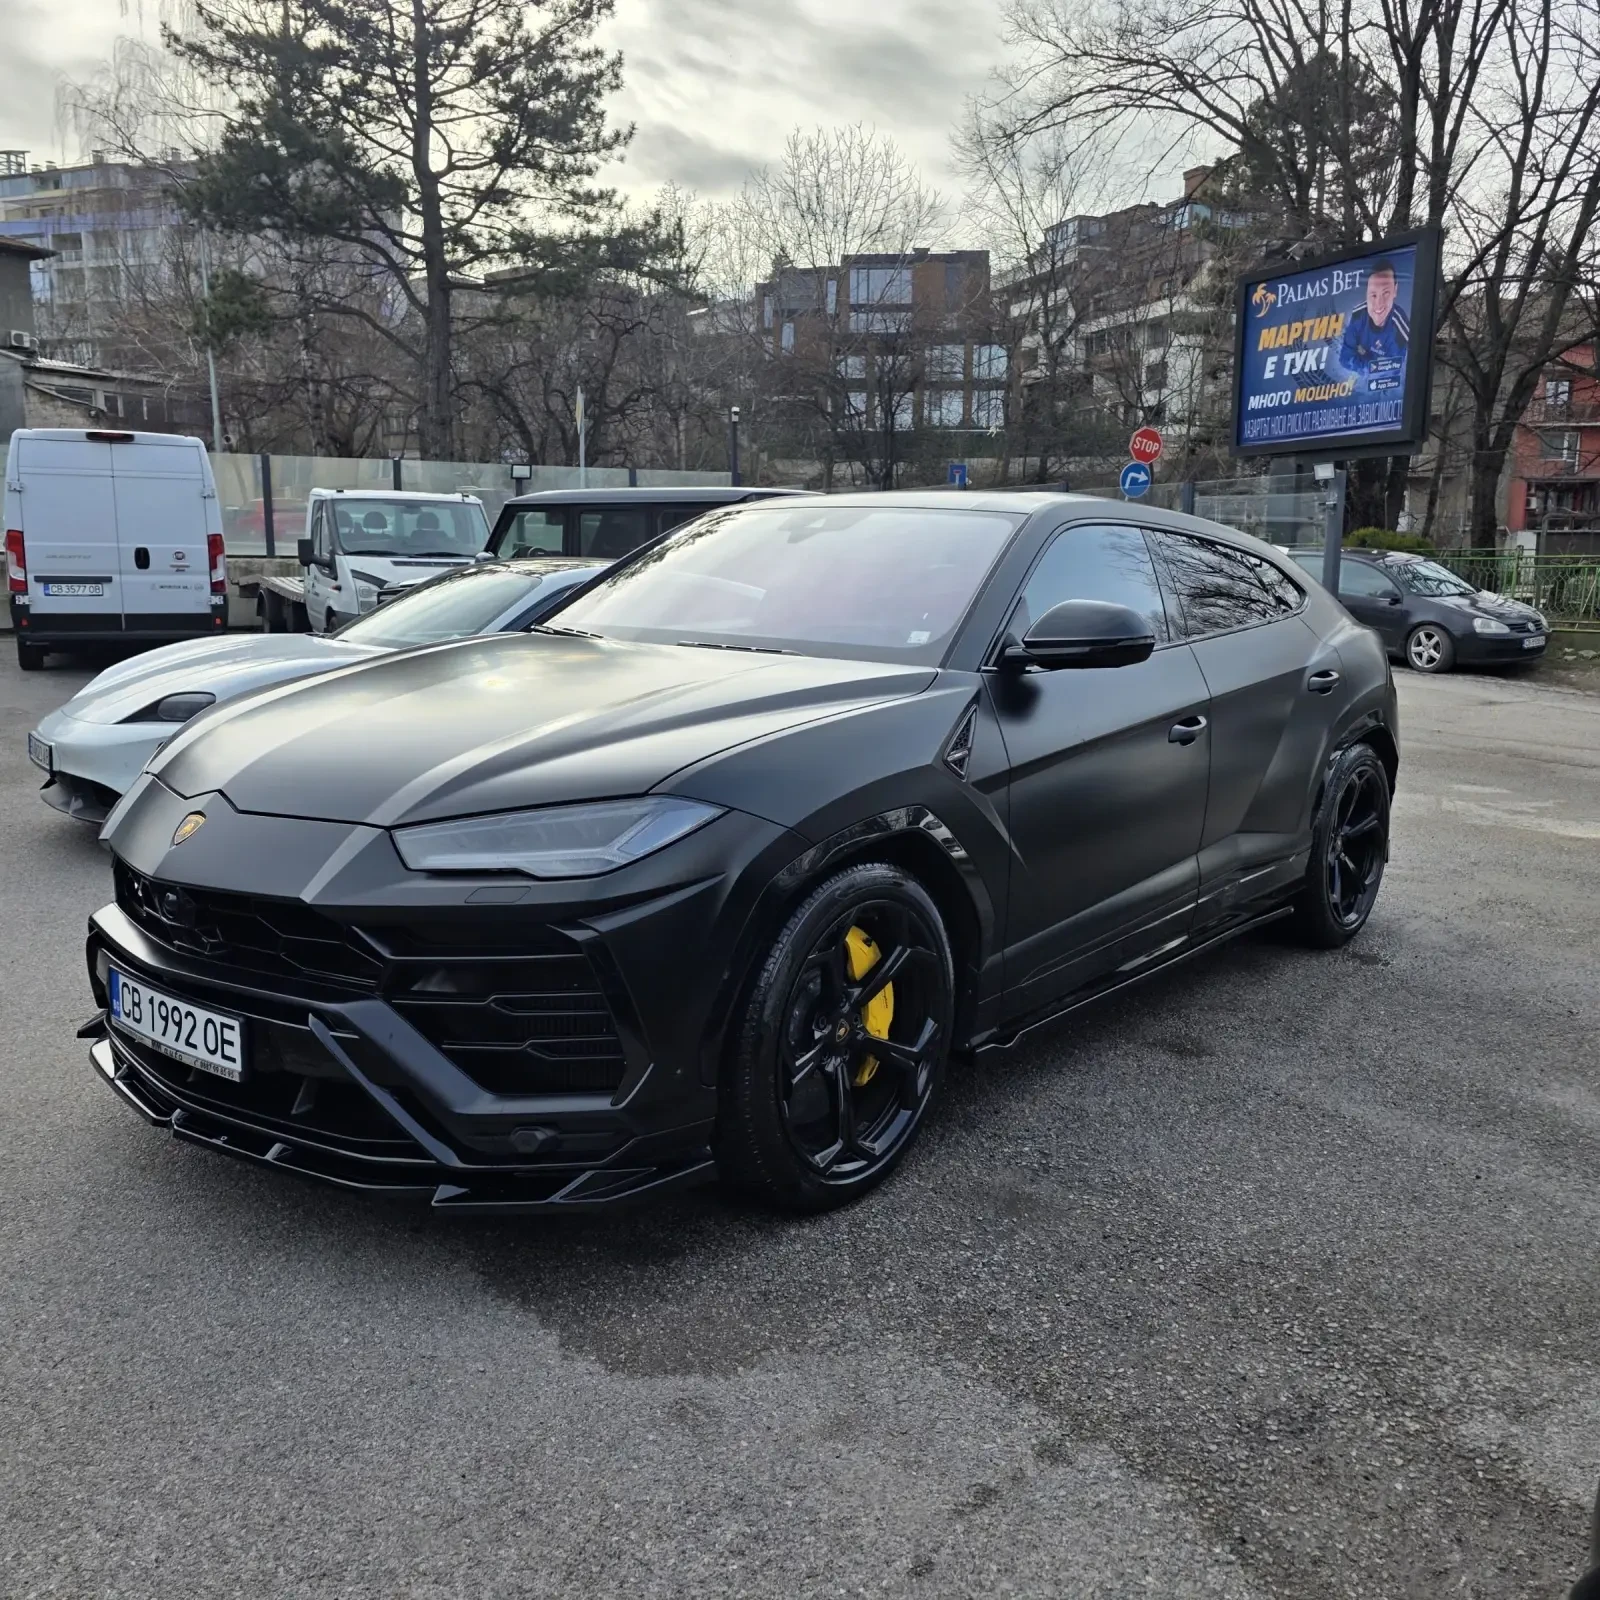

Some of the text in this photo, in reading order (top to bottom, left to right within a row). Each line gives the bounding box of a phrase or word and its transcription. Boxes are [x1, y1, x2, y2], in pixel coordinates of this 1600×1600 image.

[1276, 269, 1364, 307] PALMS BET
[1258, 312, 1345, 351] МАРТИН
[1264, 346, 1329, 379] Е ТУК!
[1248, 376, 1356, 410] МНОГО МОЩНО!
[1287, 413, 1302, 433] РИСК
[1303, 411, 1311, 431] ОТ
[1348, 406, 1356, 427] НА
[1133, 437, 1159, 453] STOP
[51, 585, 63, 593] CB
[64, 585, 86, 593] 3577
[121, 982, 142, 1024] CB
[148, 996, 198, 1050] 1992
[203, 1017, 237, 1064] OE
